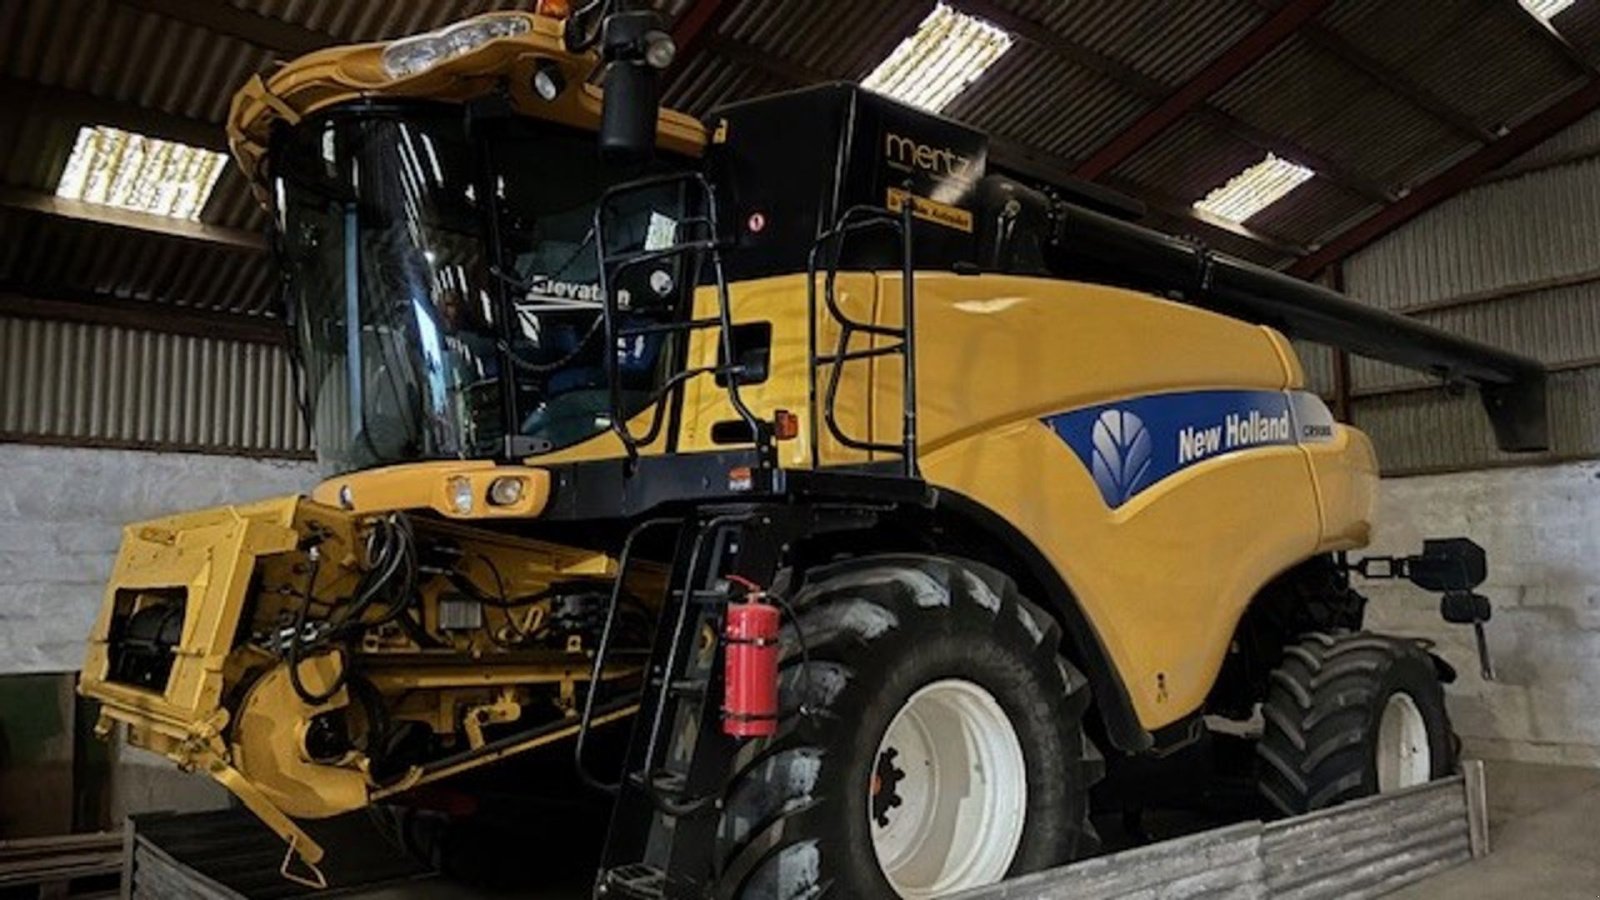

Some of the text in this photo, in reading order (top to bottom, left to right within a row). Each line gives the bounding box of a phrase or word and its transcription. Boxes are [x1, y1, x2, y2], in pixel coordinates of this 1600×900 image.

[531, 275, 631, 308] Elevatn
[1178, 409, 1290, 464] New Holland
